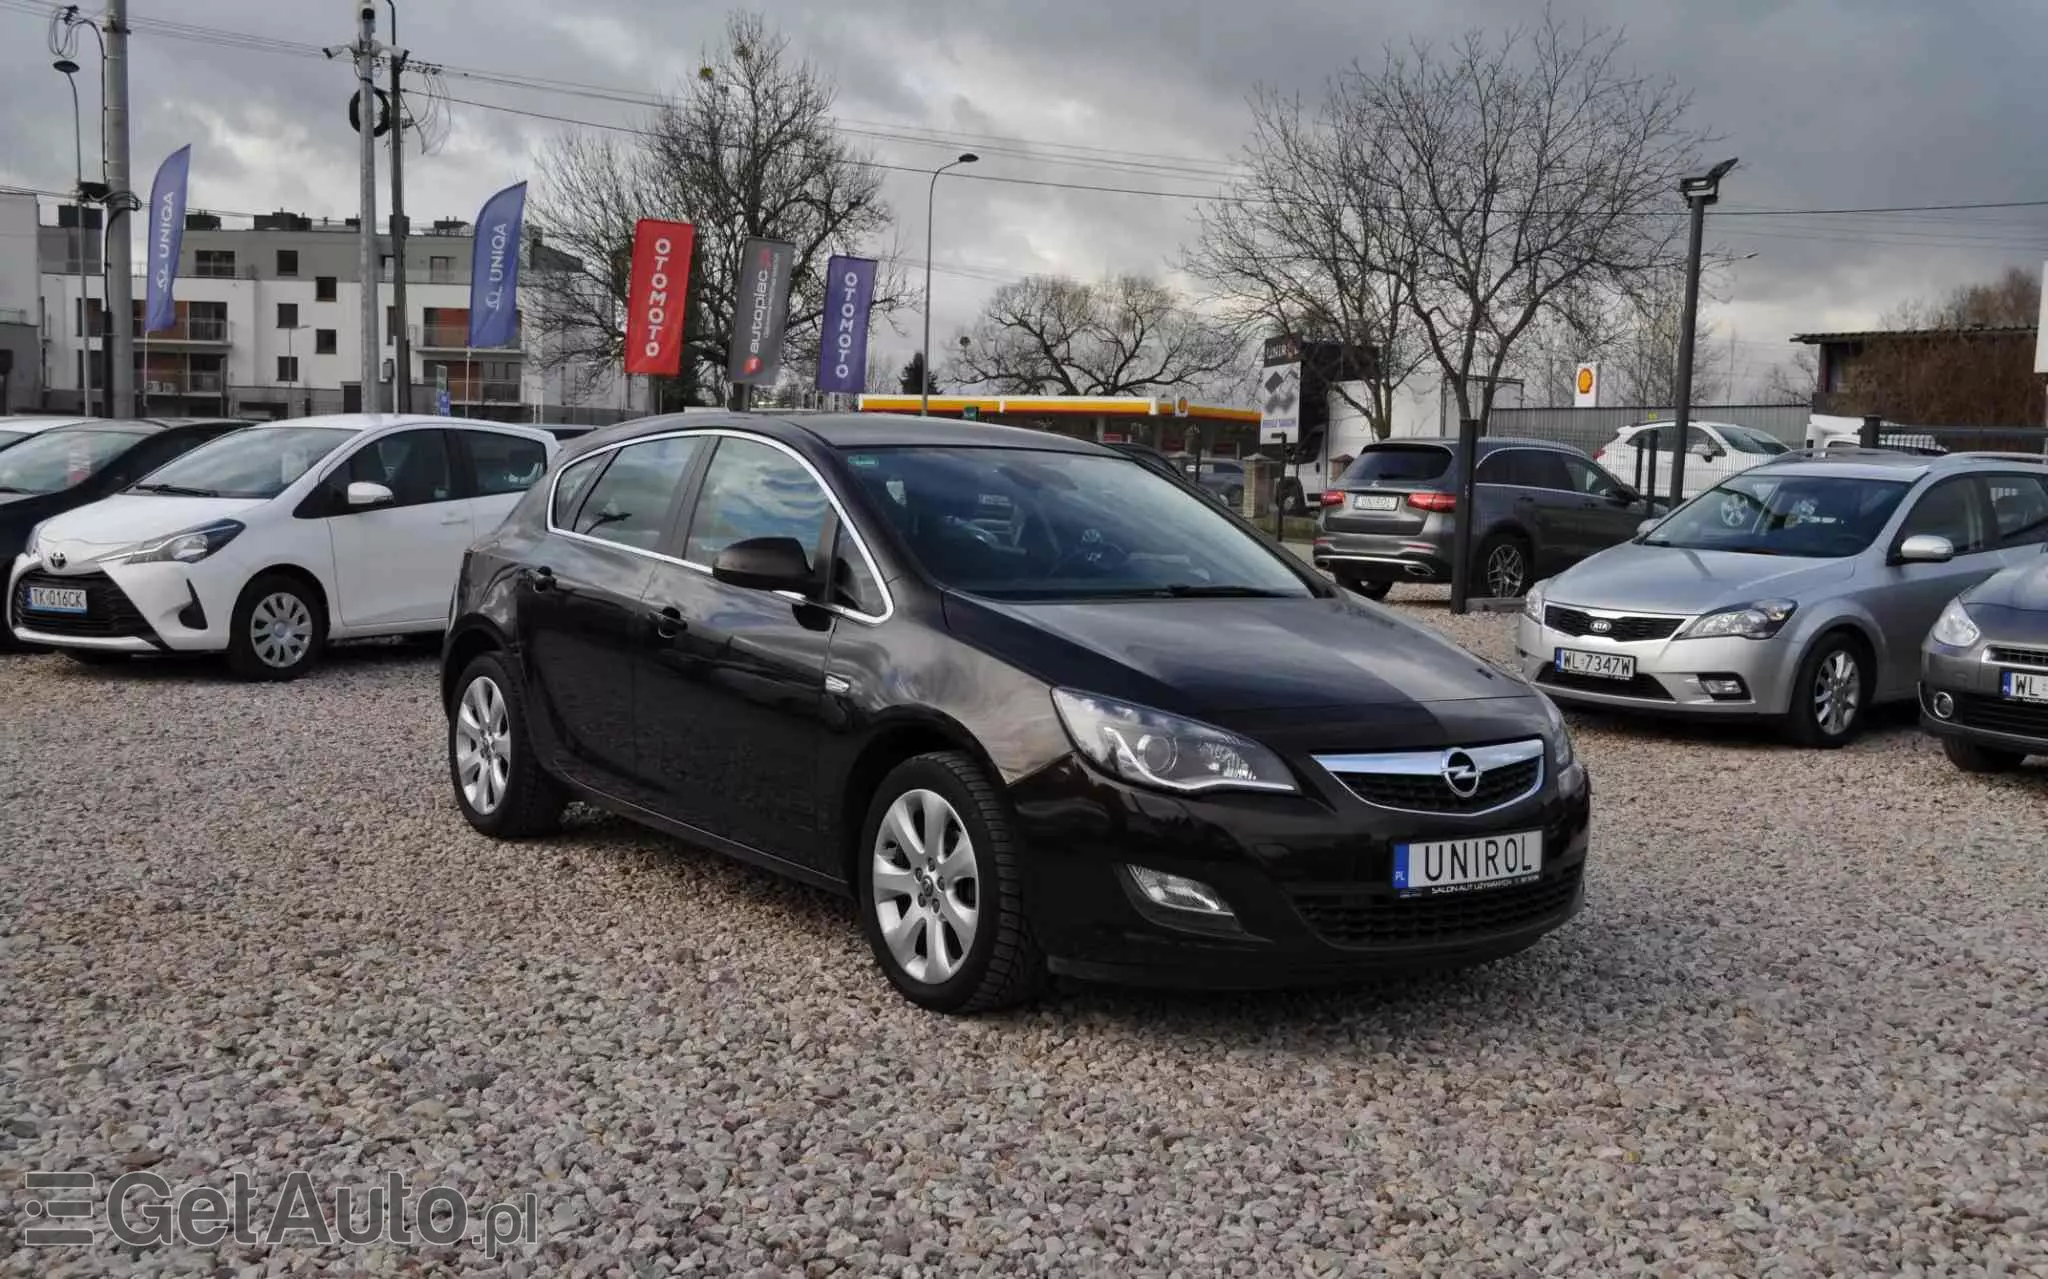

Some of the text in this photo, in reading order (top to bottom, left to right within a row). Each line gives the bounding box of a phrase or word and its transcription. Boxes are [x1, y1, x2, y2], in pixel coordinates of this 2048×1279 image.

[159, 191, 174, 258] UNIQA
[489, 223, 506, 281] UNIQA
[645, 238, 671, 357] OTOMOTO
[835, 271, 858, 379] OTOMOTO
[1563, 651, 1578, 669] WL
[1585, 654, 1631, 675] 7347W
[2015, 675, 2039, 697] WL
[1394, 871, 1406, 881] PL
[1424, 834, 1532, 882] UNIROL
